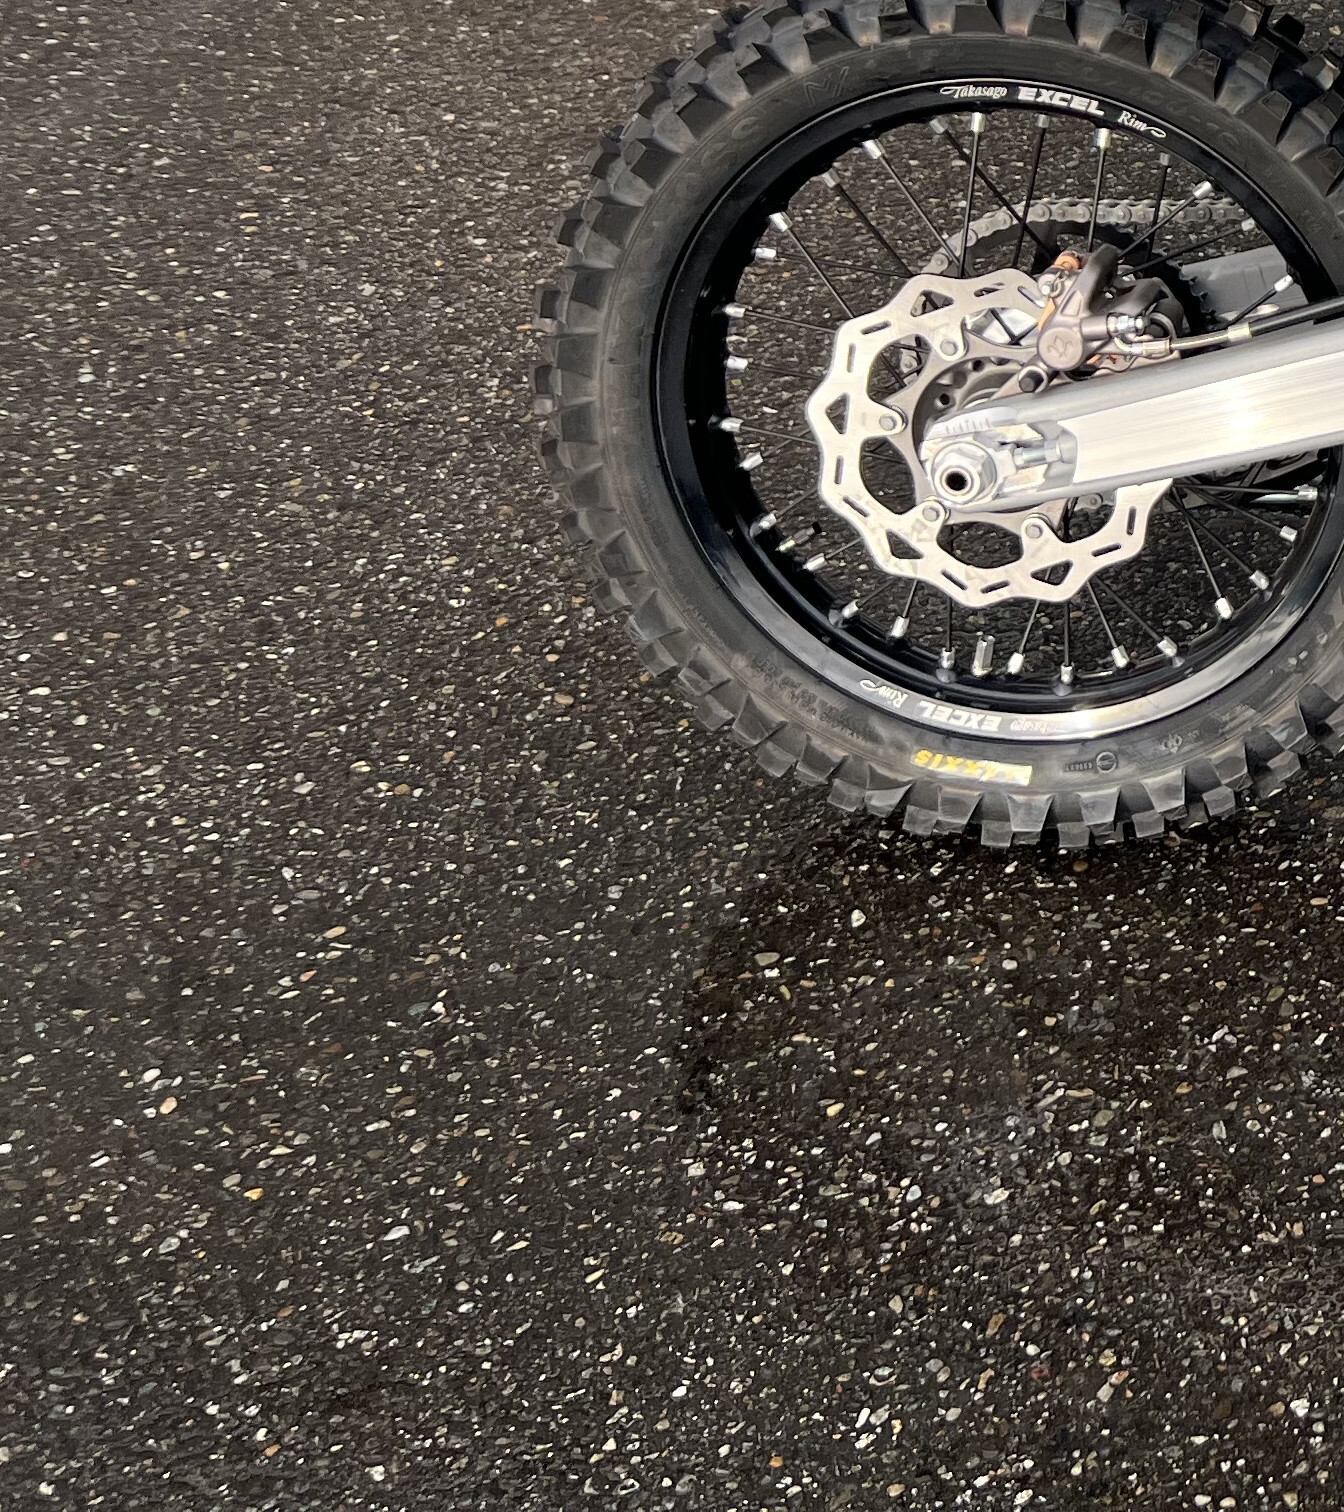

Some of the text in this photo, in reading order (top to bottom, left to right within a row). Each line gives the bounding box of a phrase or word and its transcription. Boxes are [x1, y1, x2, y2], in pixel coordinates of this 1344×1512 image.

[939, 84, 1168, 139] Takasago EXCEL Rim
[858, 678, 909, 709] Rim
[918, 699, 1003, 732] EXCEL
